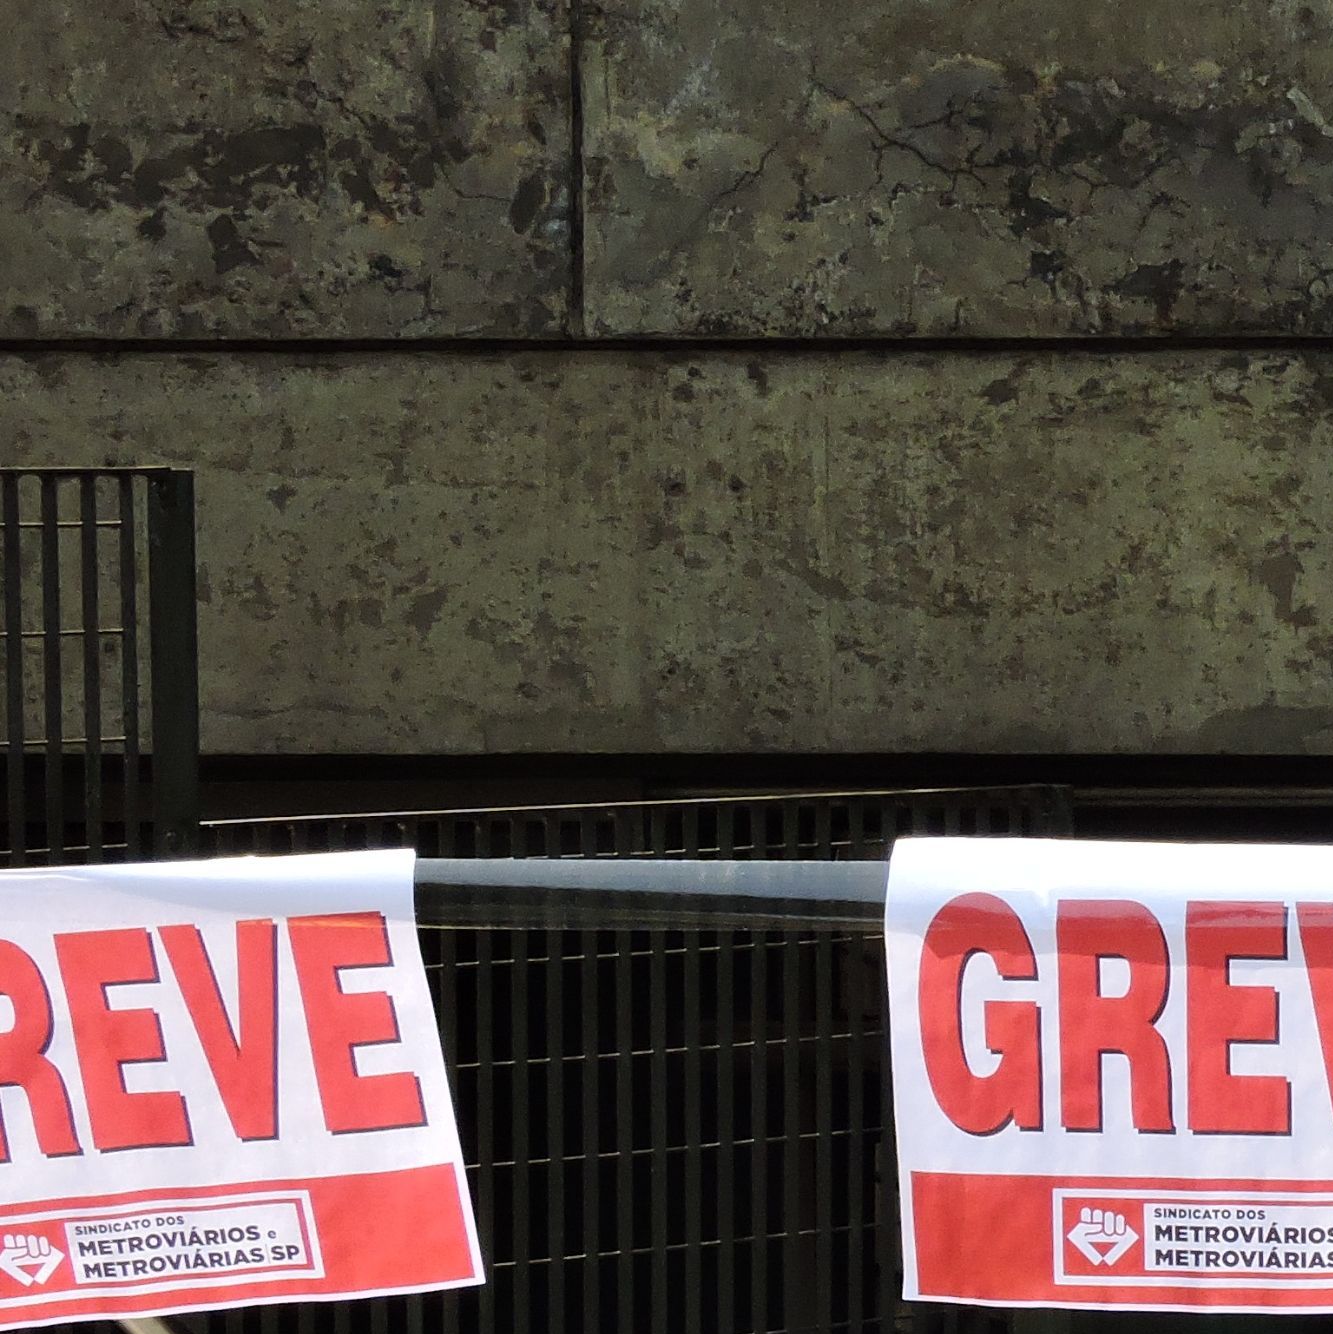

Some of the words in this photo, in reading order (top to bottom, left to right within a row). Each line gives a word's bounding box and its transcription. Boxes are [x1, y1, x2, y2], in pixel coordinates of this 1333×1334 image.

[75, 1219, 150, 1235] SINDICATO
[156, 1216, 184, 1227] DOS
[1154, 1208, 1231, 1219] SINDICATO
[1236, 1210, 1265, 1219] DOS
[78, 1226, 260, 1257] METROVIÁRIOS
[83, 1248, 264, 1278] METROVIÁRIAS
[271, 1245, 300, 1260] SP
